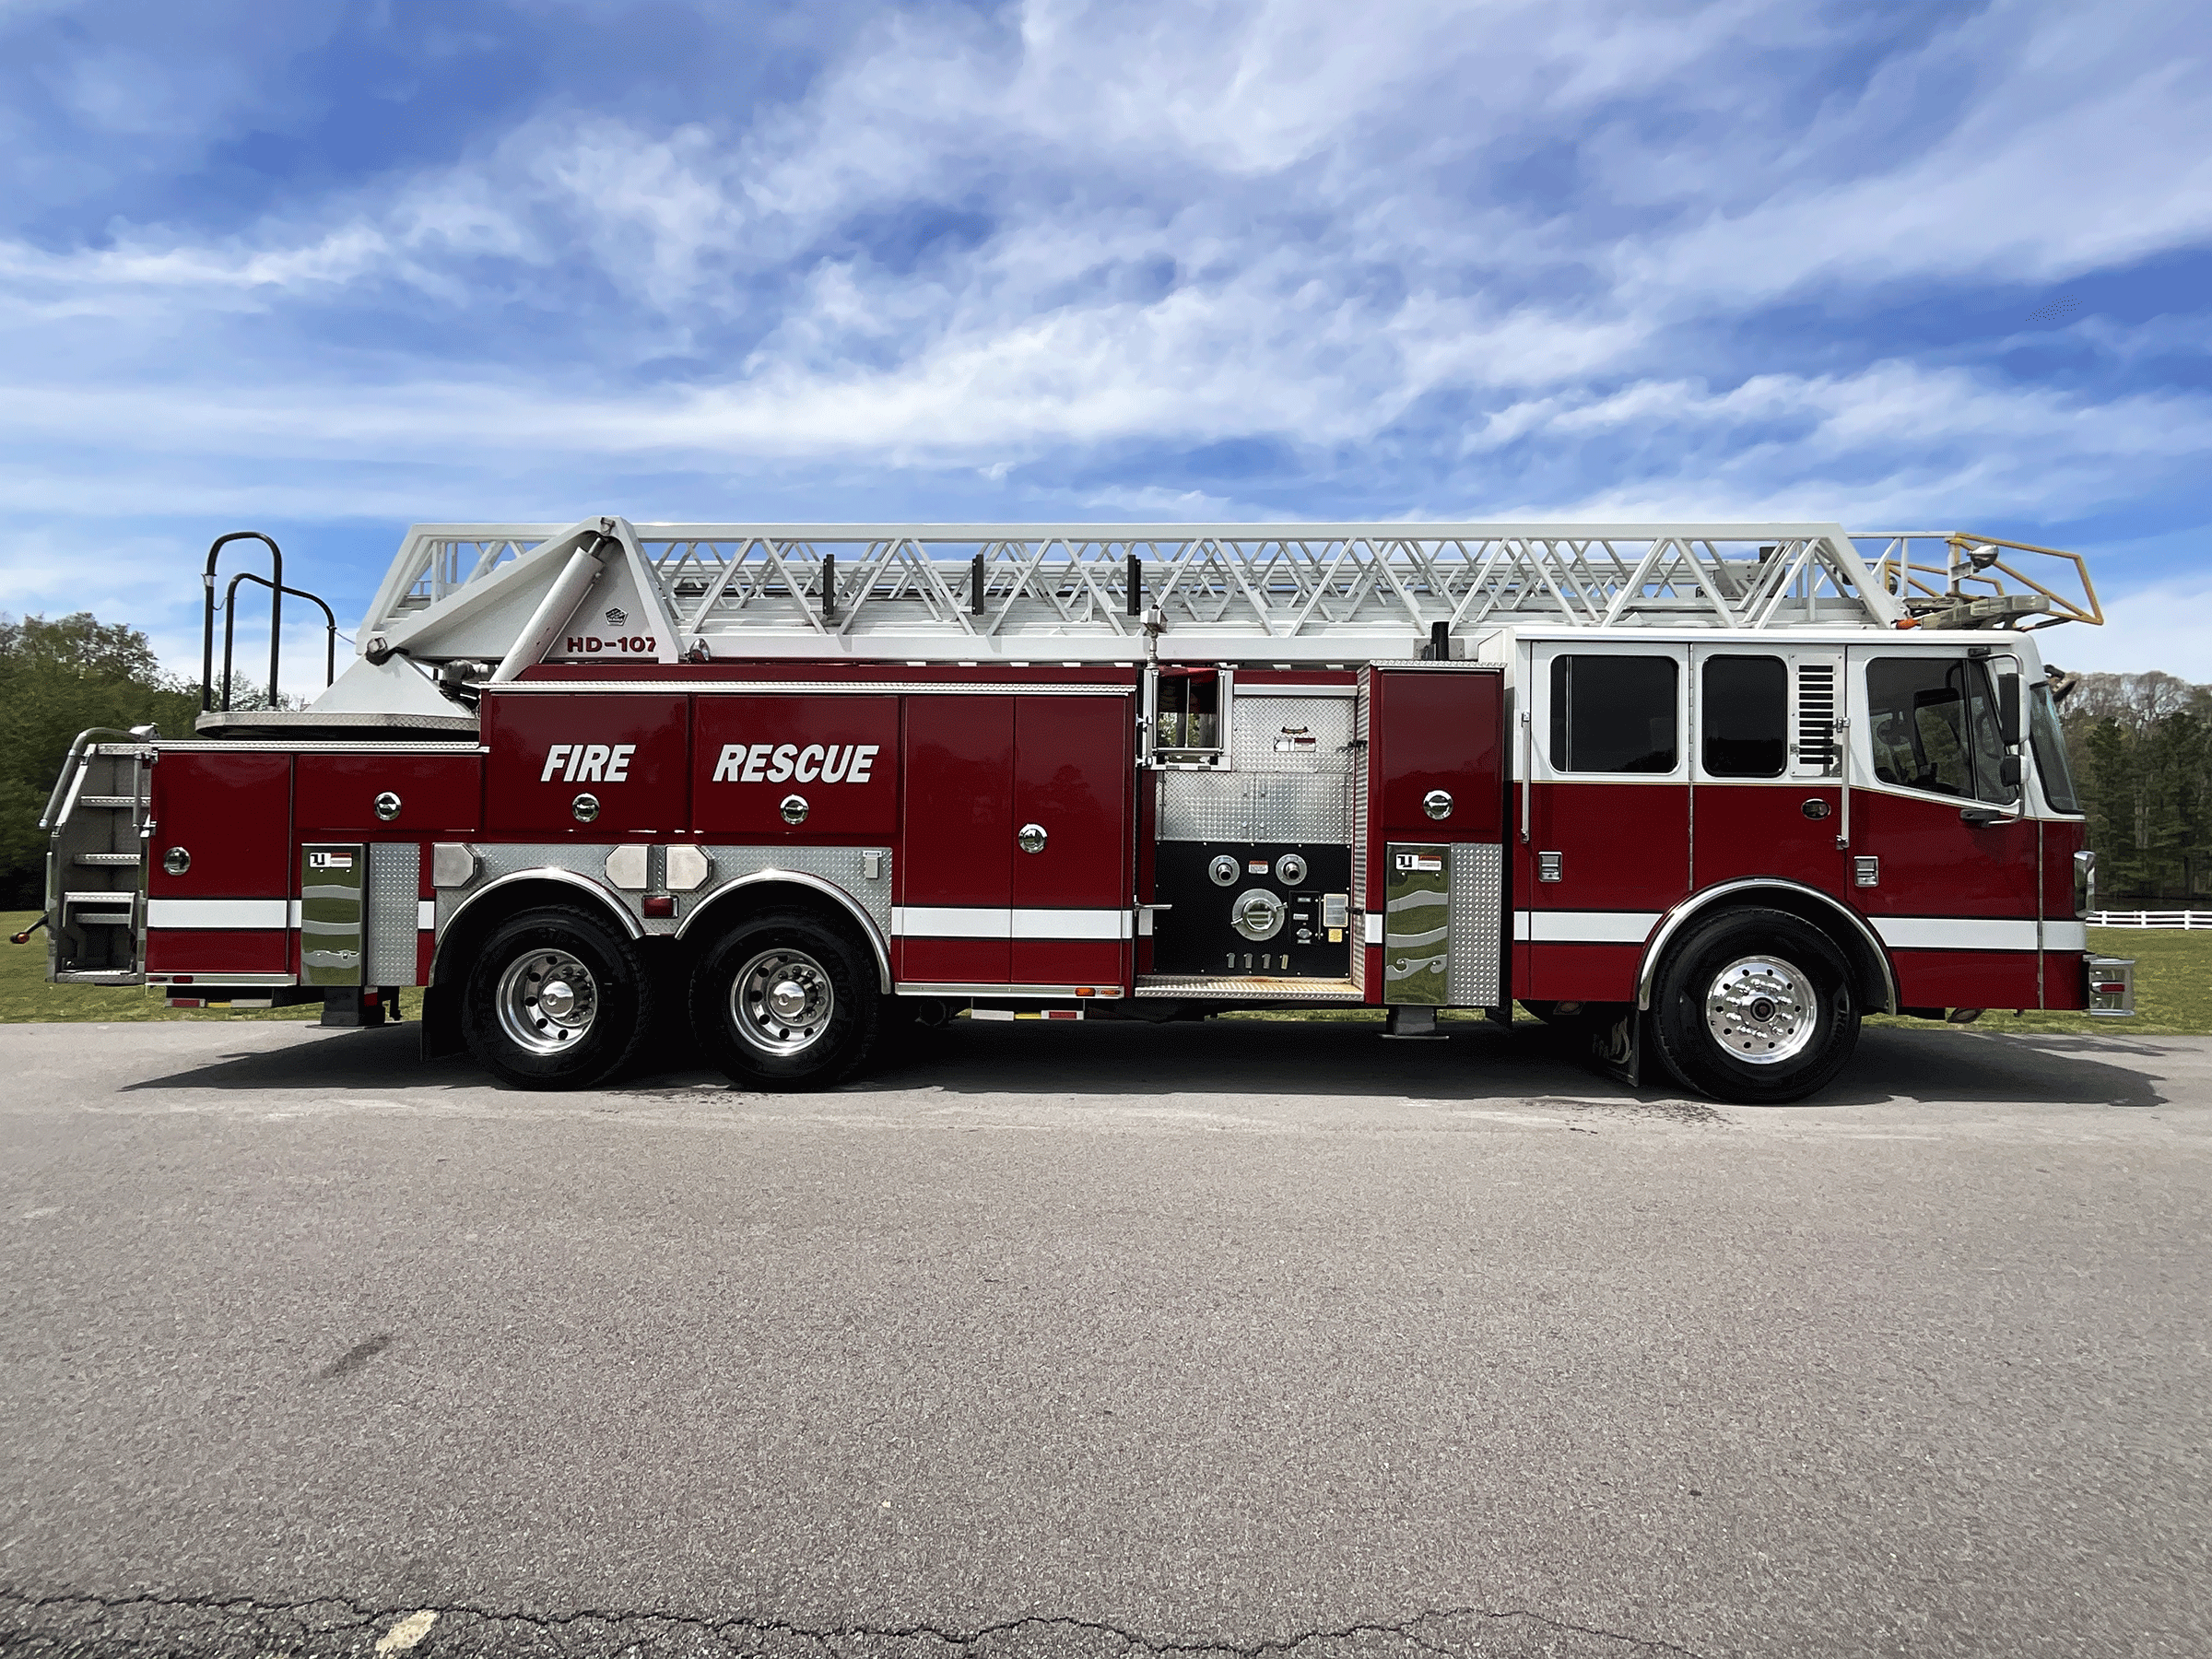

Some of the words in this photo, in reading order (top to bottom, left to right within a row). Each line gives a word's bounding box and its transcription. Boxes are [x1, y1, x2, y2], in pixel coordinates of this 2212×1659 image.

[567, 636, 657, 653] HD-107
[540, 744, 637, 782] FIRE
[712, 743, 880, 783] RESCUE
